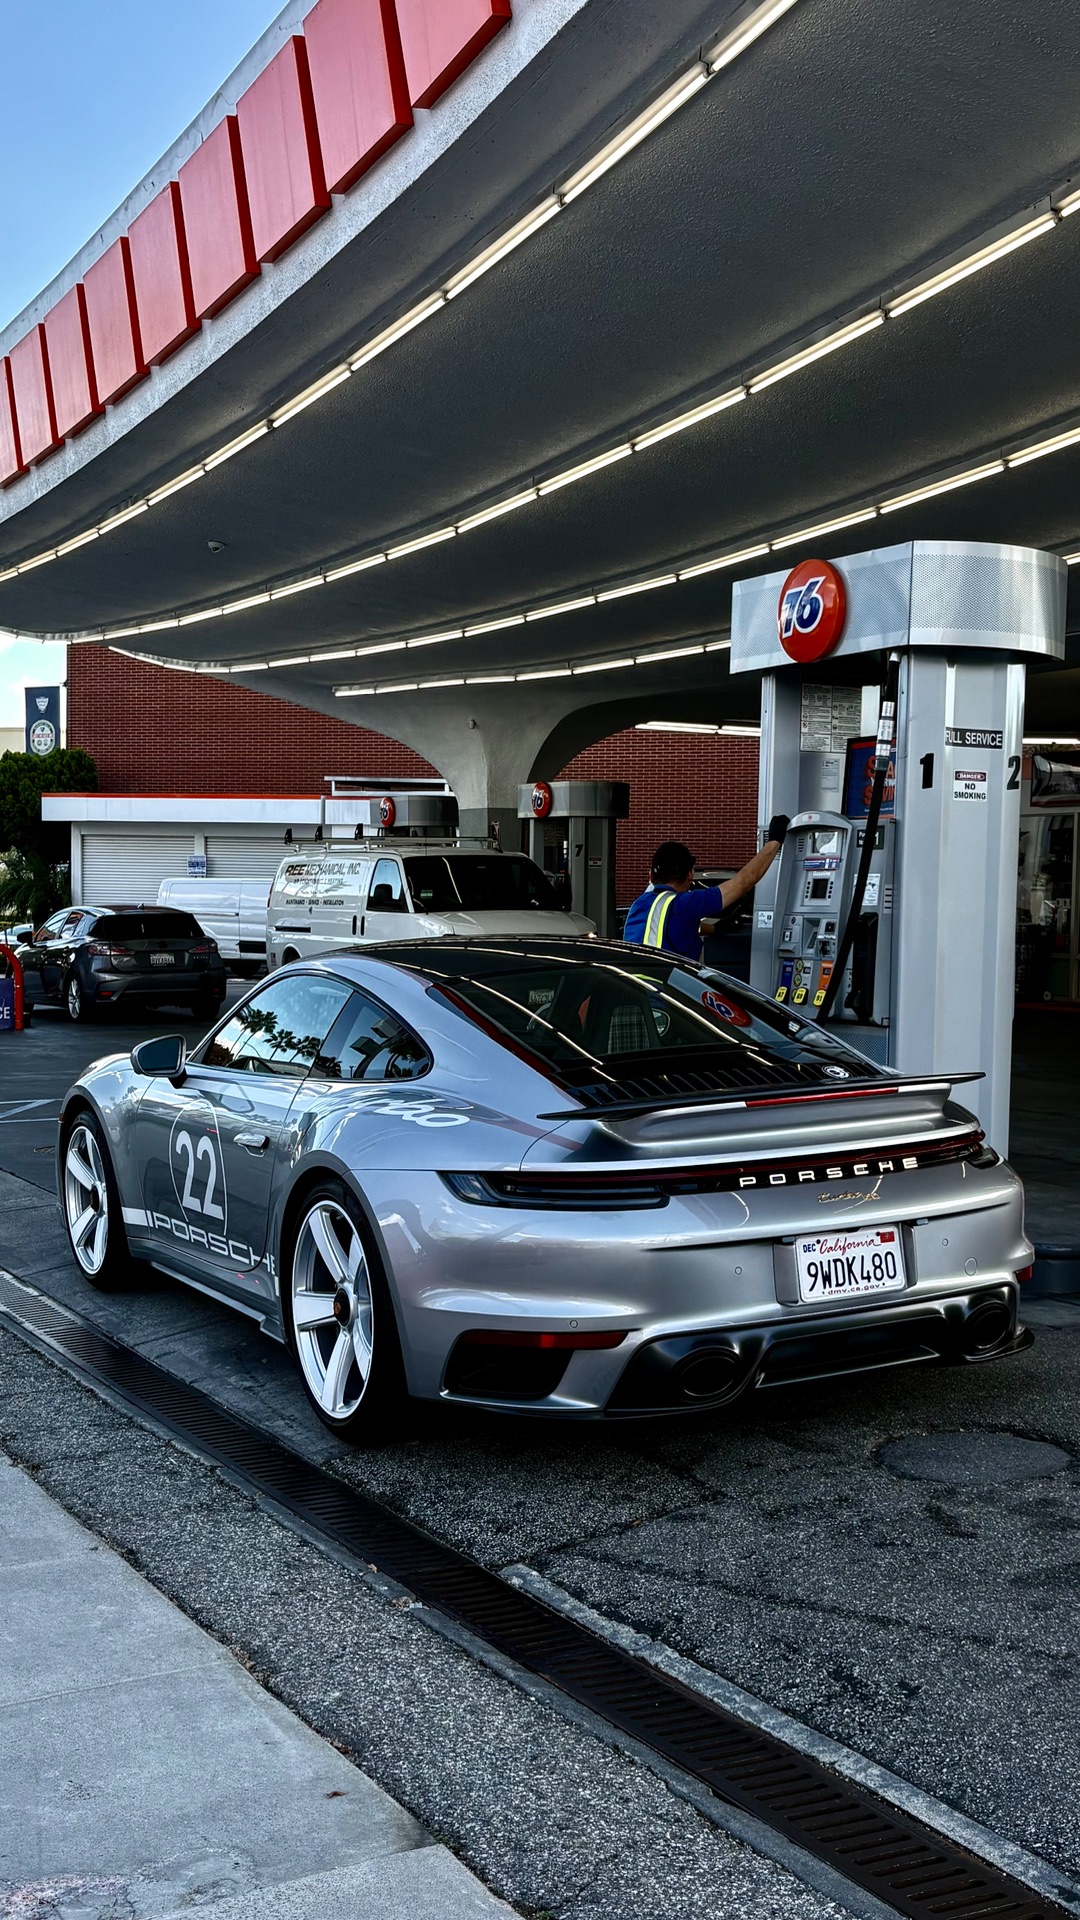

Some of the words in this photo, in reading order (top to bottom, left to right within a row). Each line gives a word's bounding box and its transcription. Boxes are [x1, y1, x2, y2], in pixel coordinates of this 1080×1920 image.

[780, 576, 826, 639] 76
[945, 731, 962, 744] FULL
[965, 732, 1002, 746] SERVICE
[919, 753, 934, 789] 1
[960, 772, 981, 780] DANGER
[1007, 755, 1021, 790] 2
[954, 791, 986, 800] SMOKING
[575, 844, 583, 857] 7
[175, 1130, 224, 1220] 22
[740, 1157, 918, 1187] PORSCHE
[803, 1244, 816, 1253] DEC
[820, 1237, 881, 1256] California
[807, 1251, 897, 1292] 9WDK480
[828, 1284, 880, 1296] dmv.ca.gov
